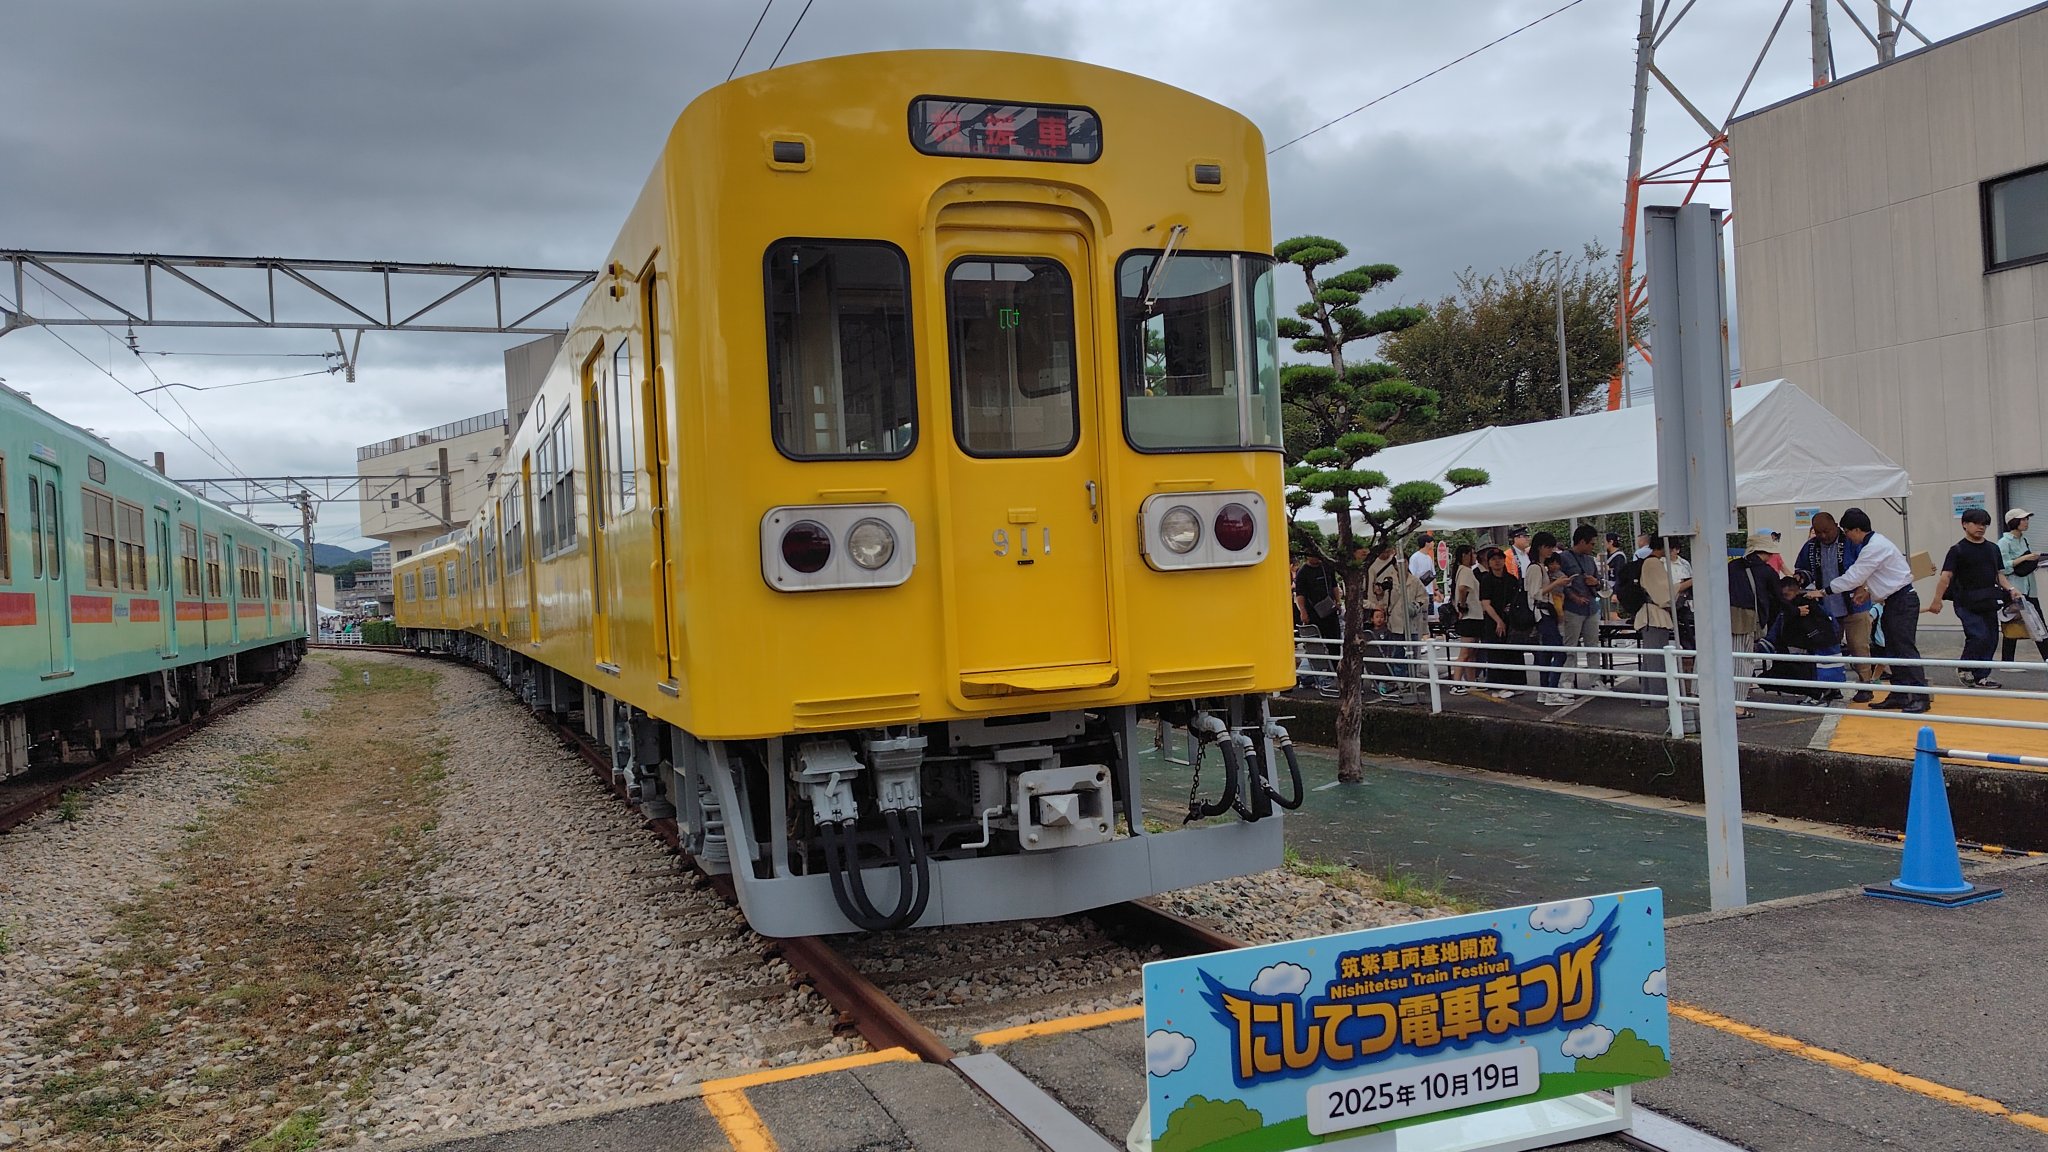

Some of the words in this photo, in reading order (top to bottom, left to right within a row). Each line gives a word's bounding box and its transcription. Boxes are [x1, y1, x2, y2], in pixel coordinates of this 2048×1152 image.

[992, 528, 1051, 557] 911
[1341, 935, 1497, 979] 筑紫車両基地開放
[1330, 977, 1408, 1000] Nishitetsu
[1411, 970, 1449, 986] Train
[1452, 959, 1510, 980] Festival
[1222, 934, 1603, 1079] にしてつ電車まつり
[1328, 1063, 1519, 1118] 2025年10月19日
